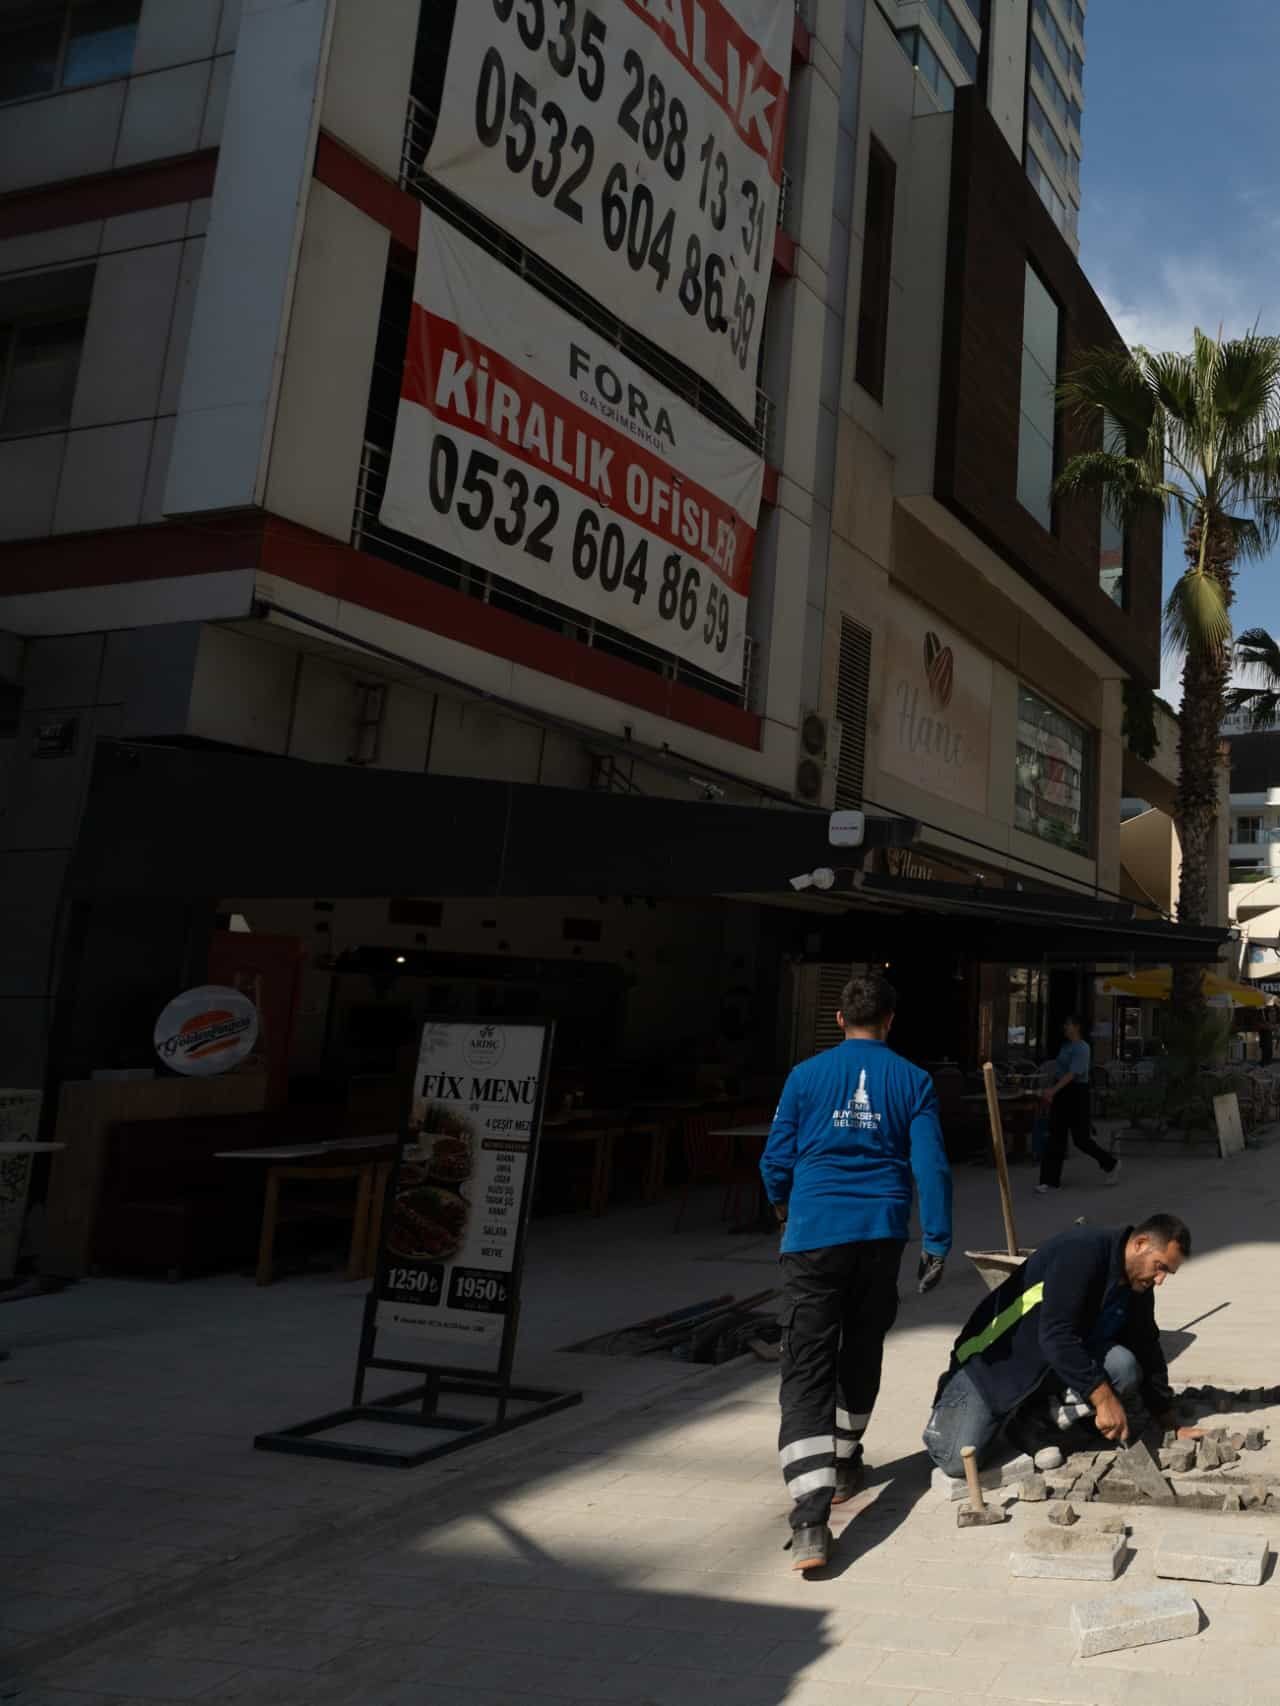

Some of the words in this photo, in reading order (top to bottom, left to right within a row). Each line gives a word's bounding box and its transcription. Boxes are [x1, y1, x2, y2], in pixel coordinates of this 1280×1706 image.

[475, 46, 594, 223] 0532
[601, 162, 676, 292] 604
[679, 233, 727, 333] 86
[731, 275, 756, 370] 59
[617, 48, 688, 181] 288
[700, 133, 728, 231] 13
[740, 180, 765, 272] 31
[434, 346, 614, 499] KİRALIK
[626, 462, 738, 579] OFİSLER
[569, 342, 676, 447] FORA
[429, 433, 560, 562] 0532
[572, 508, 649, 605] 604
[658, 553, 701, 630] 86
[703, 582, 730, 654] 59
[421, 1071, 465, 1100] FİX
[469, 1075, 539, 1105] MENÜ
